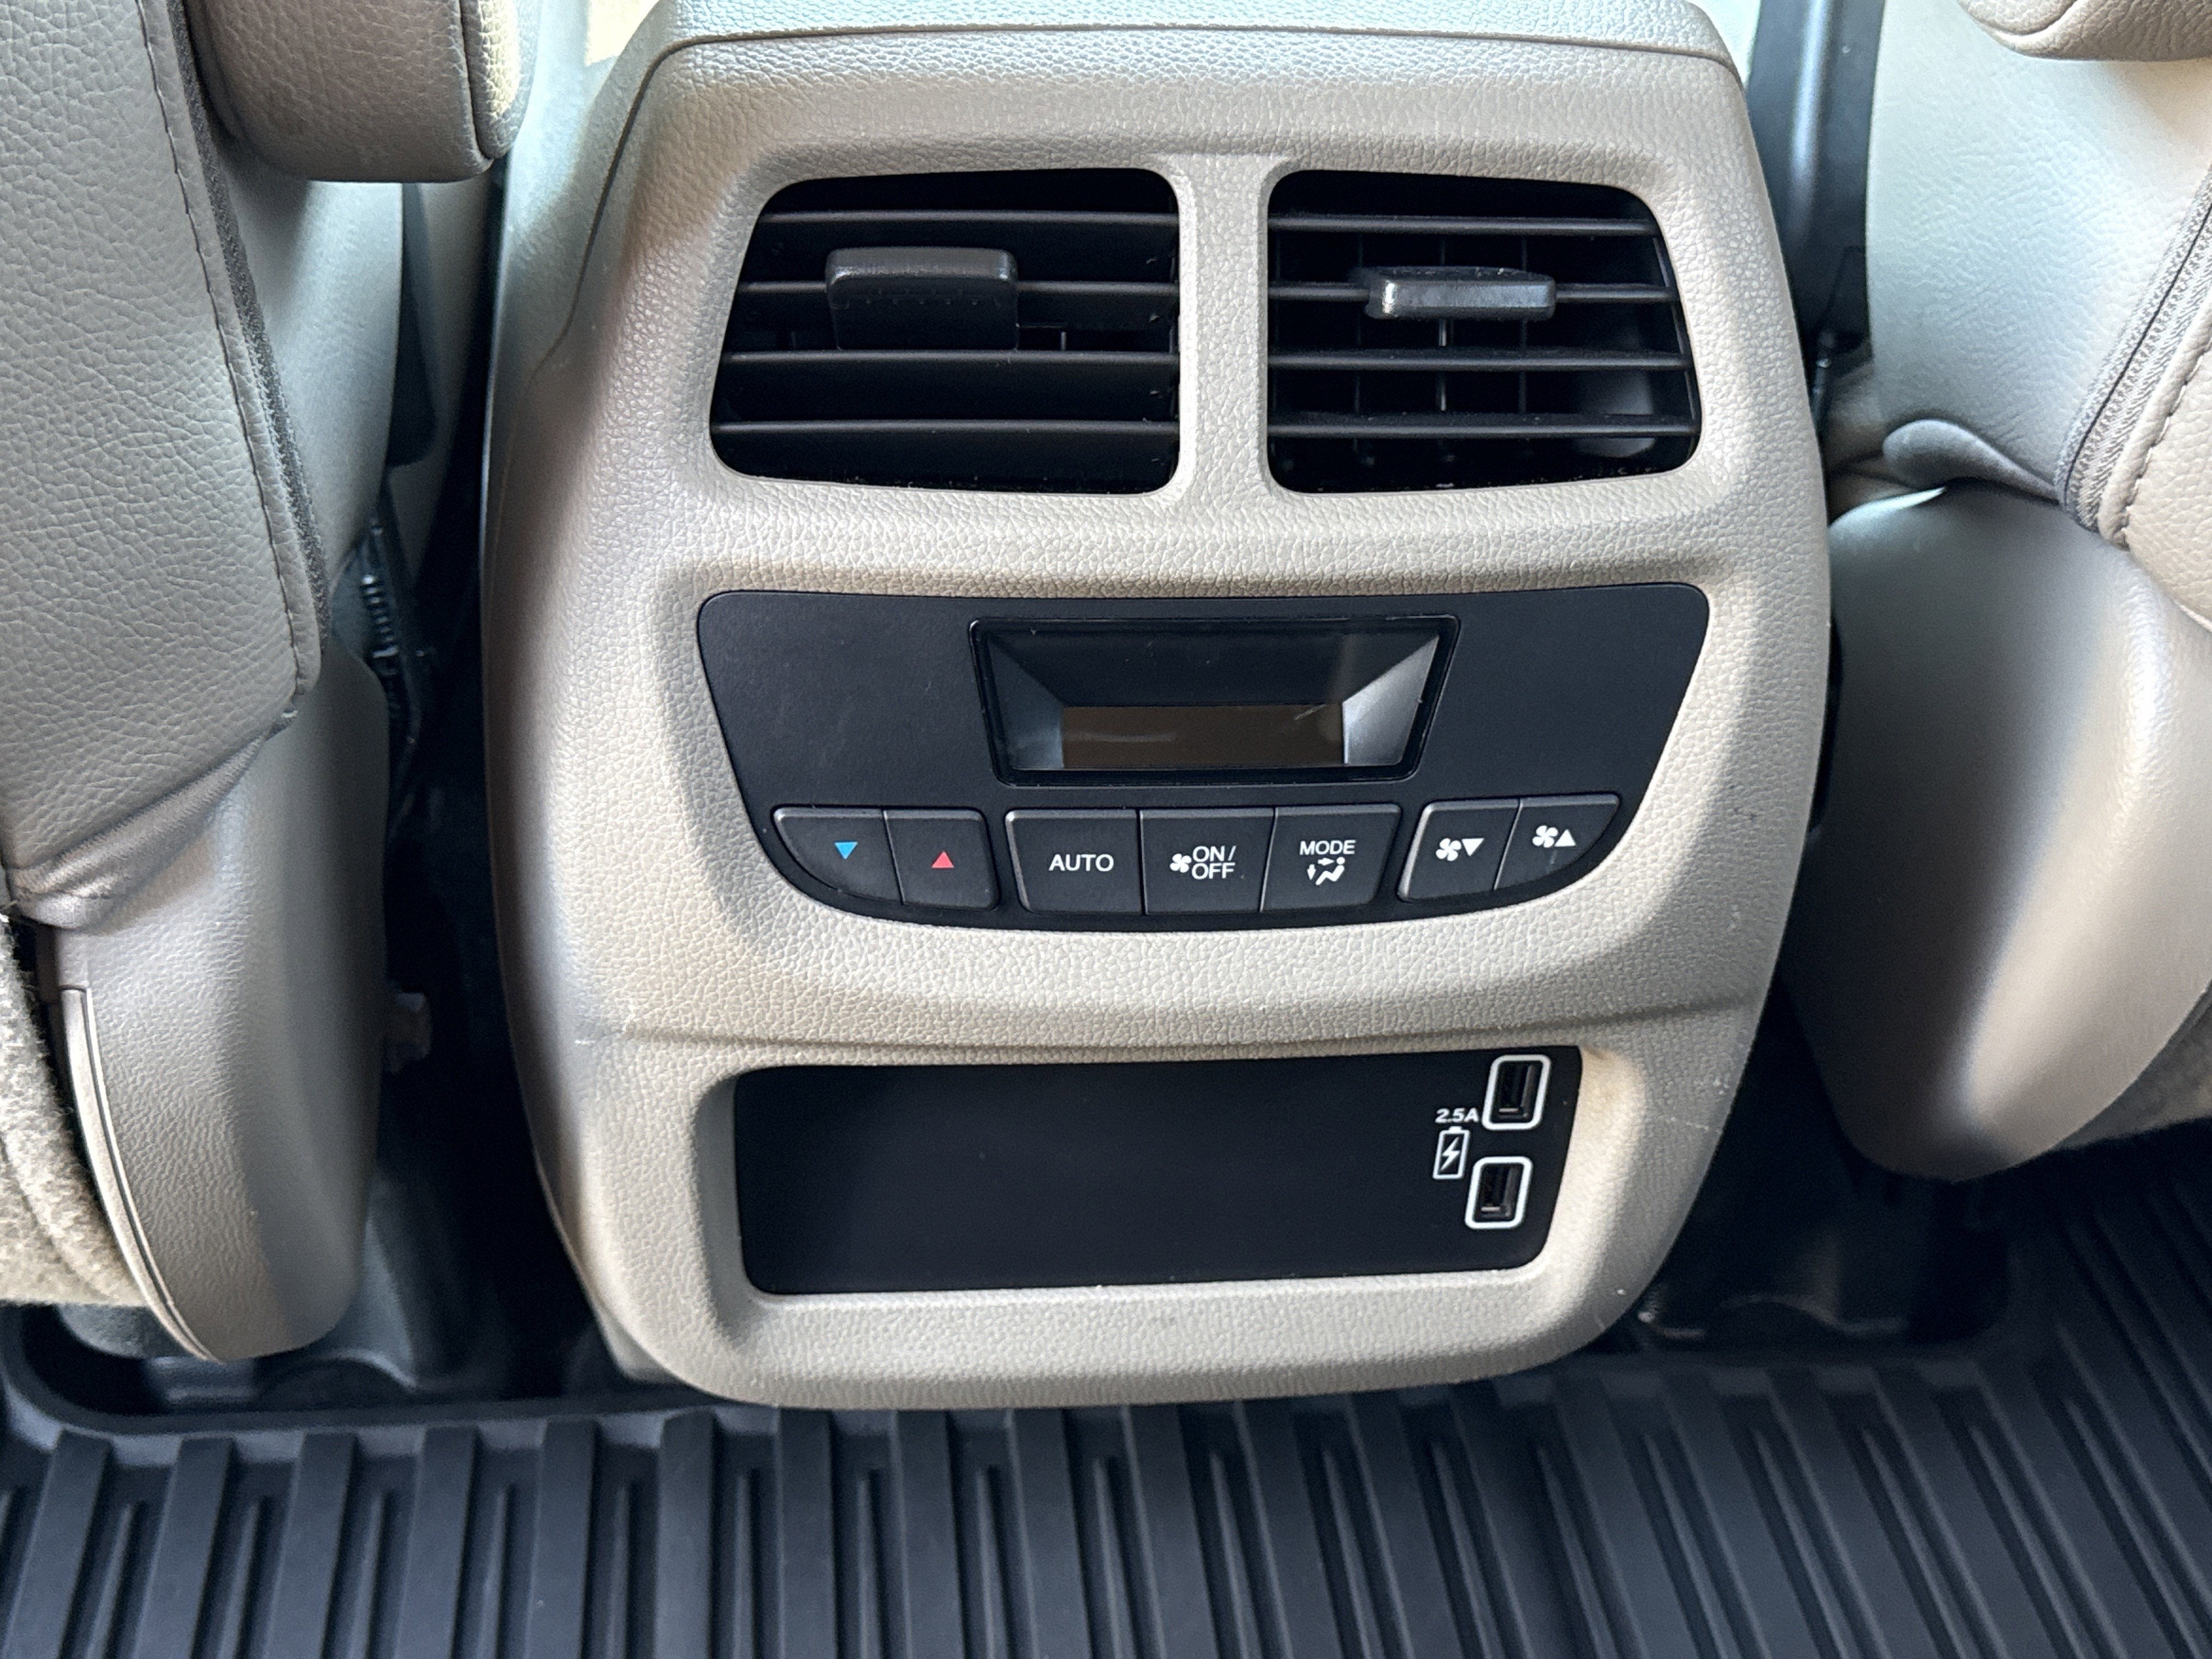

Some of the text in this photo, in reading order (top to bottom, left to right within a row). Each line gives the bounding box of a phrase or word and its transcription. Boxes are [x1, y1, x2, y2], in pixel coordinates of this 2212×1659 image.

[1192, 845, 1236, 862] ON/
[1299, 839, 1356, 855] MODE
[1048, 854, 1114, 872] AUTO
[1191, 862, 1235, 880] OFF
[1435, 1108, 1479, 1123] 2.5A
